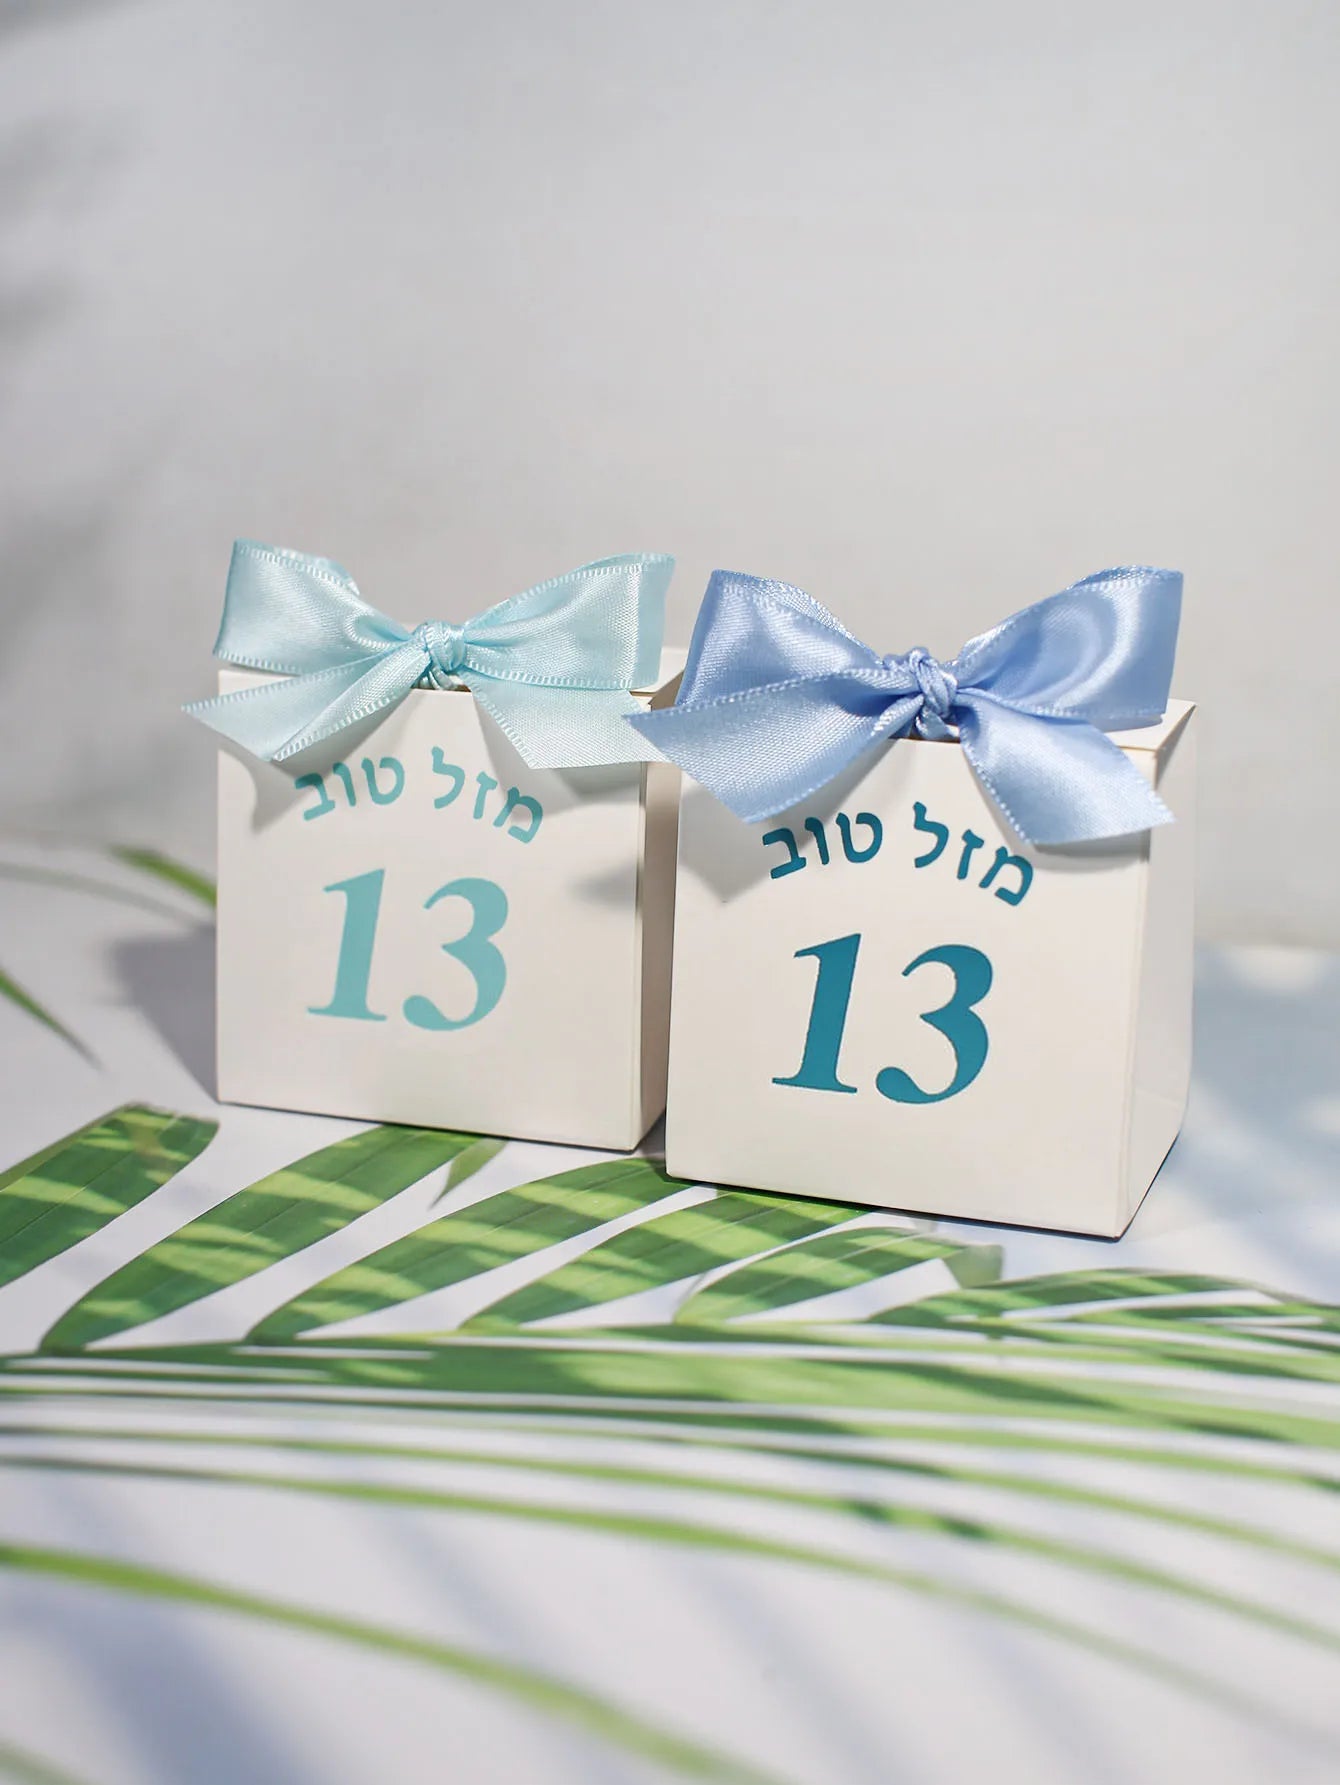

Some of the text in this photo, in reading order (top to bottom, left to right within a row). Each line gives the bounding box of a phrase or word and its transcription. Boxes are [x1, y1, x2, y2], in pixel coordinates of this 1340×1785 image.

[294, 746, 544, 844] מזל טוב
[761, 801, 1034, 906] מזל טוב
[306, 868, 509, 1031] 13
[771, 933, 994, 1105] 13
